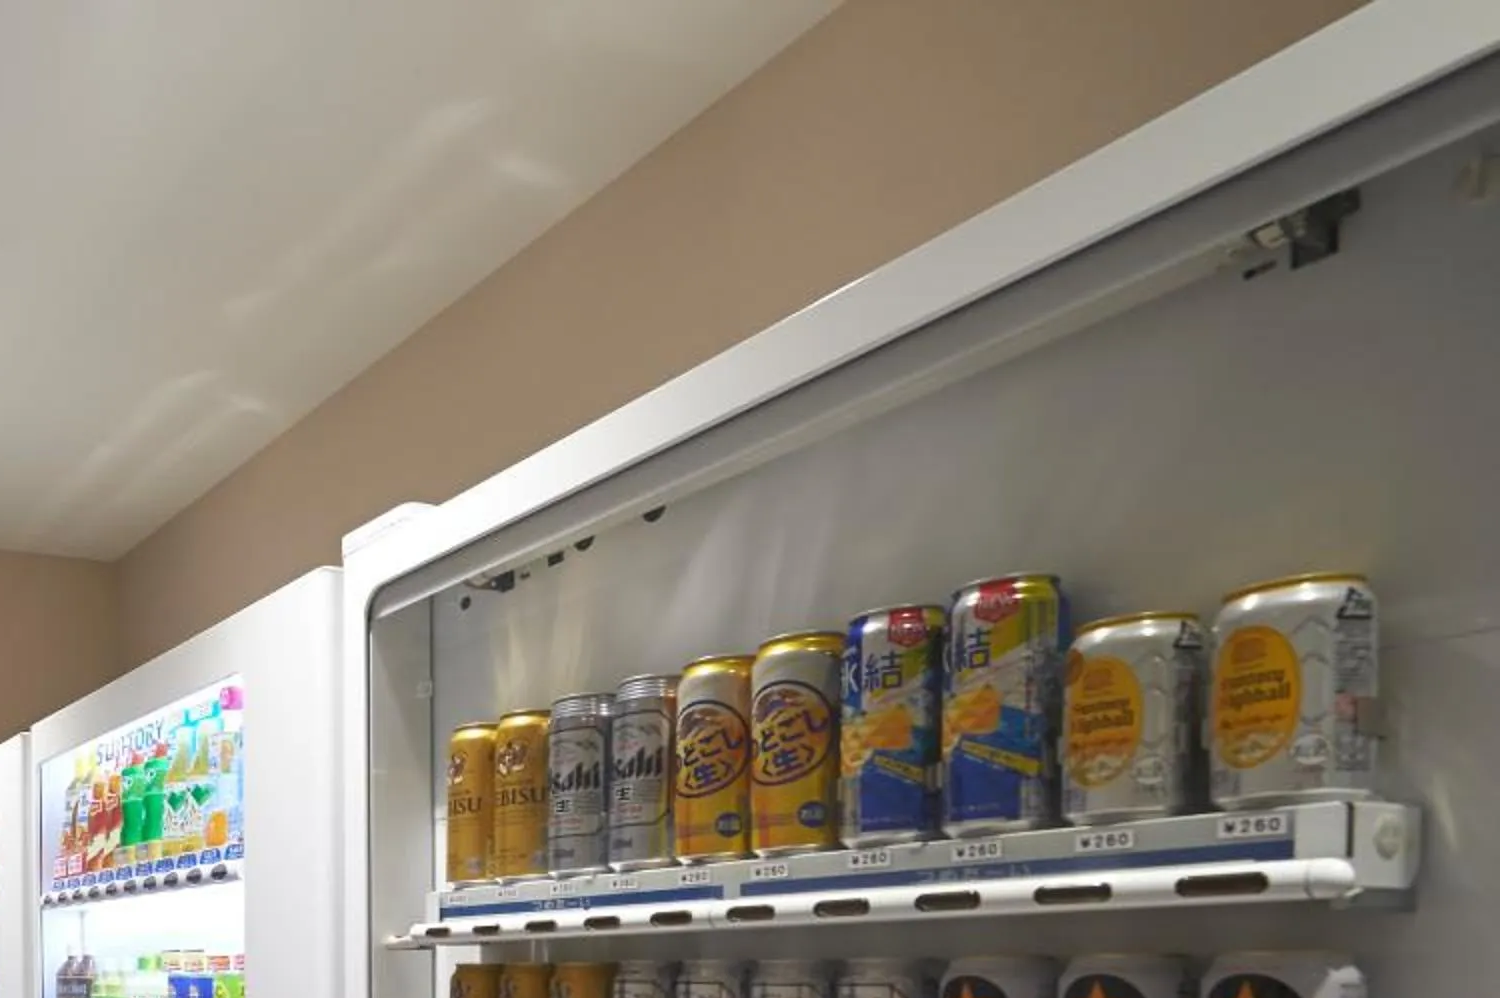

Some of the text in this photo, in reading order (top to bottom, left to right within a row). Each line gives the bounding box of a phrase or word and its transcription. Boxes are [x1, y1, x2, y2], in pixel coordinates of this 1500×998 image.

[682, 729, 741, 767] どごし
[754, 709, 829, 752] どごし
[549, 761, 600, 794] sahi
[613, 746, 663, 780] sahi
